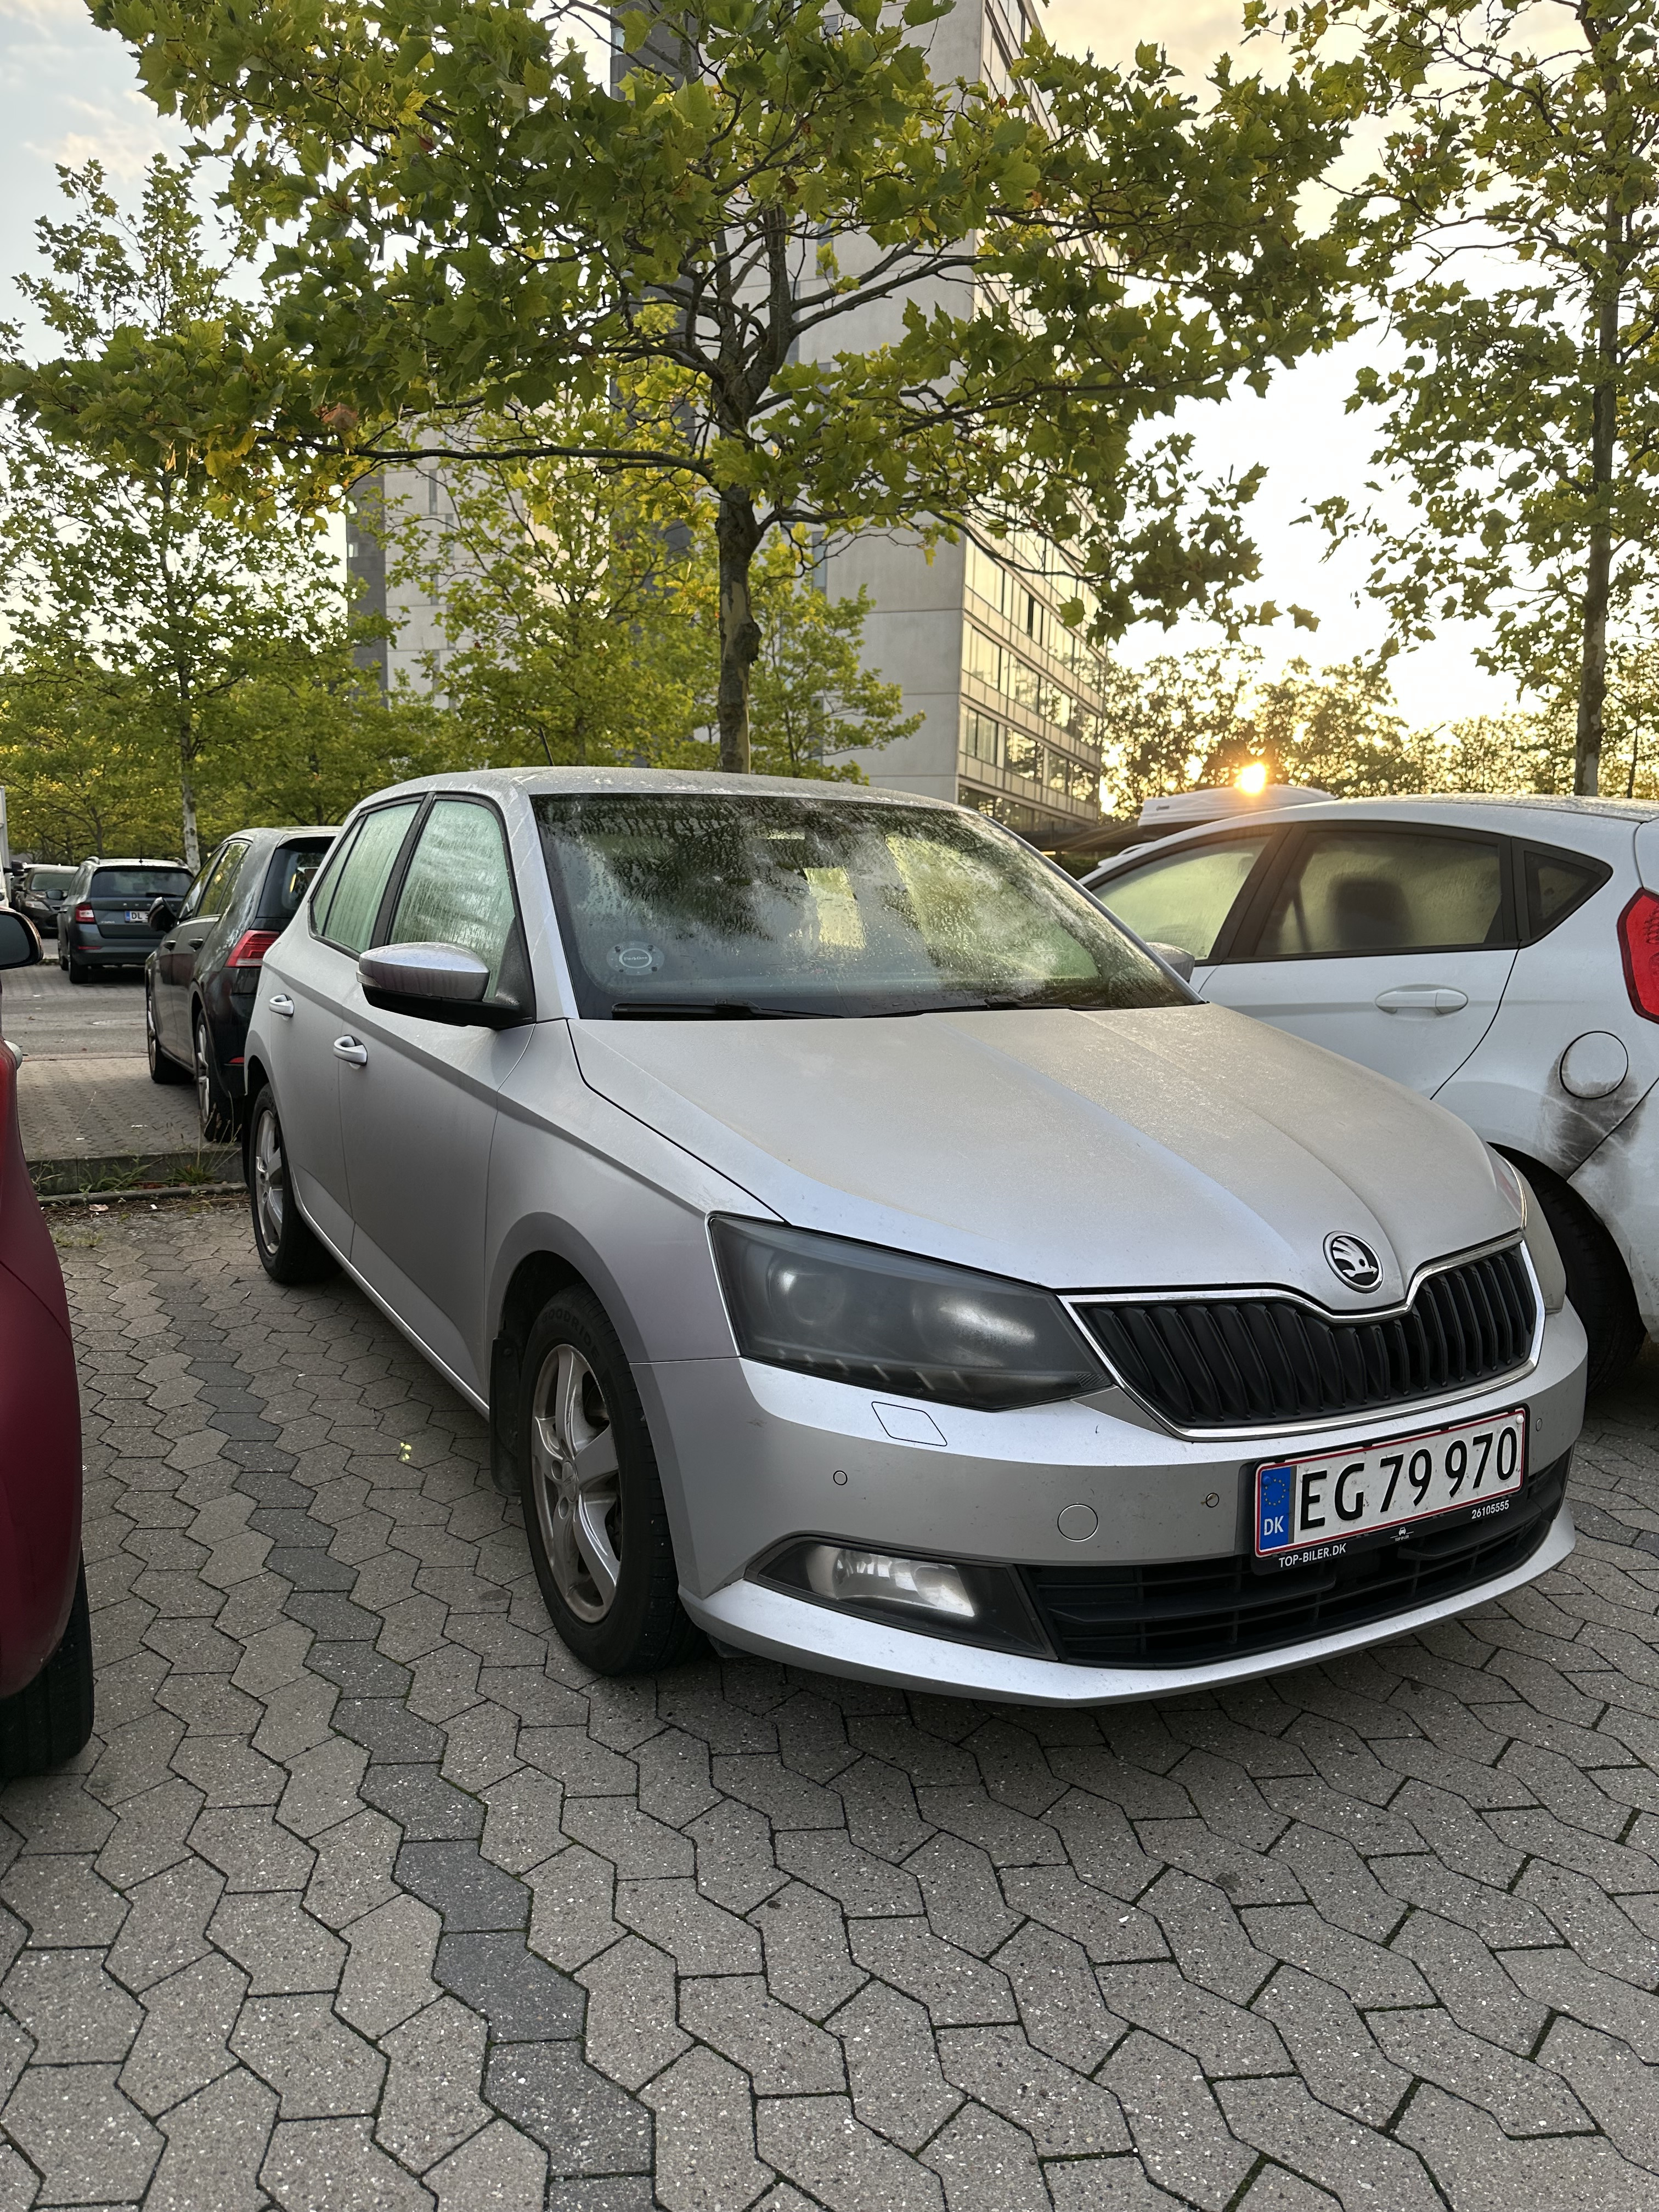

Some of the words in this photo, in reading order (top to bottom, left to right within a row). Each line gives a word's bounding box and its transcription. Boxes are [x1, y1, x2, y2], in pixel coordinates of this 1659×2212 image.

[541, 1308, 600, 1363] GOODRIDE
[1300, 1463, 1365, 1531] EG
[1380, 1448, 1432, 1513] 79
[1444, 1426, 1517, 1498] 970
[1471, 1499, 1509, 1520] 26105555
[1263, 1515, 1284, 1536] DK
[1278, 1543, 1347, 1568] TOP-BILER.DK
